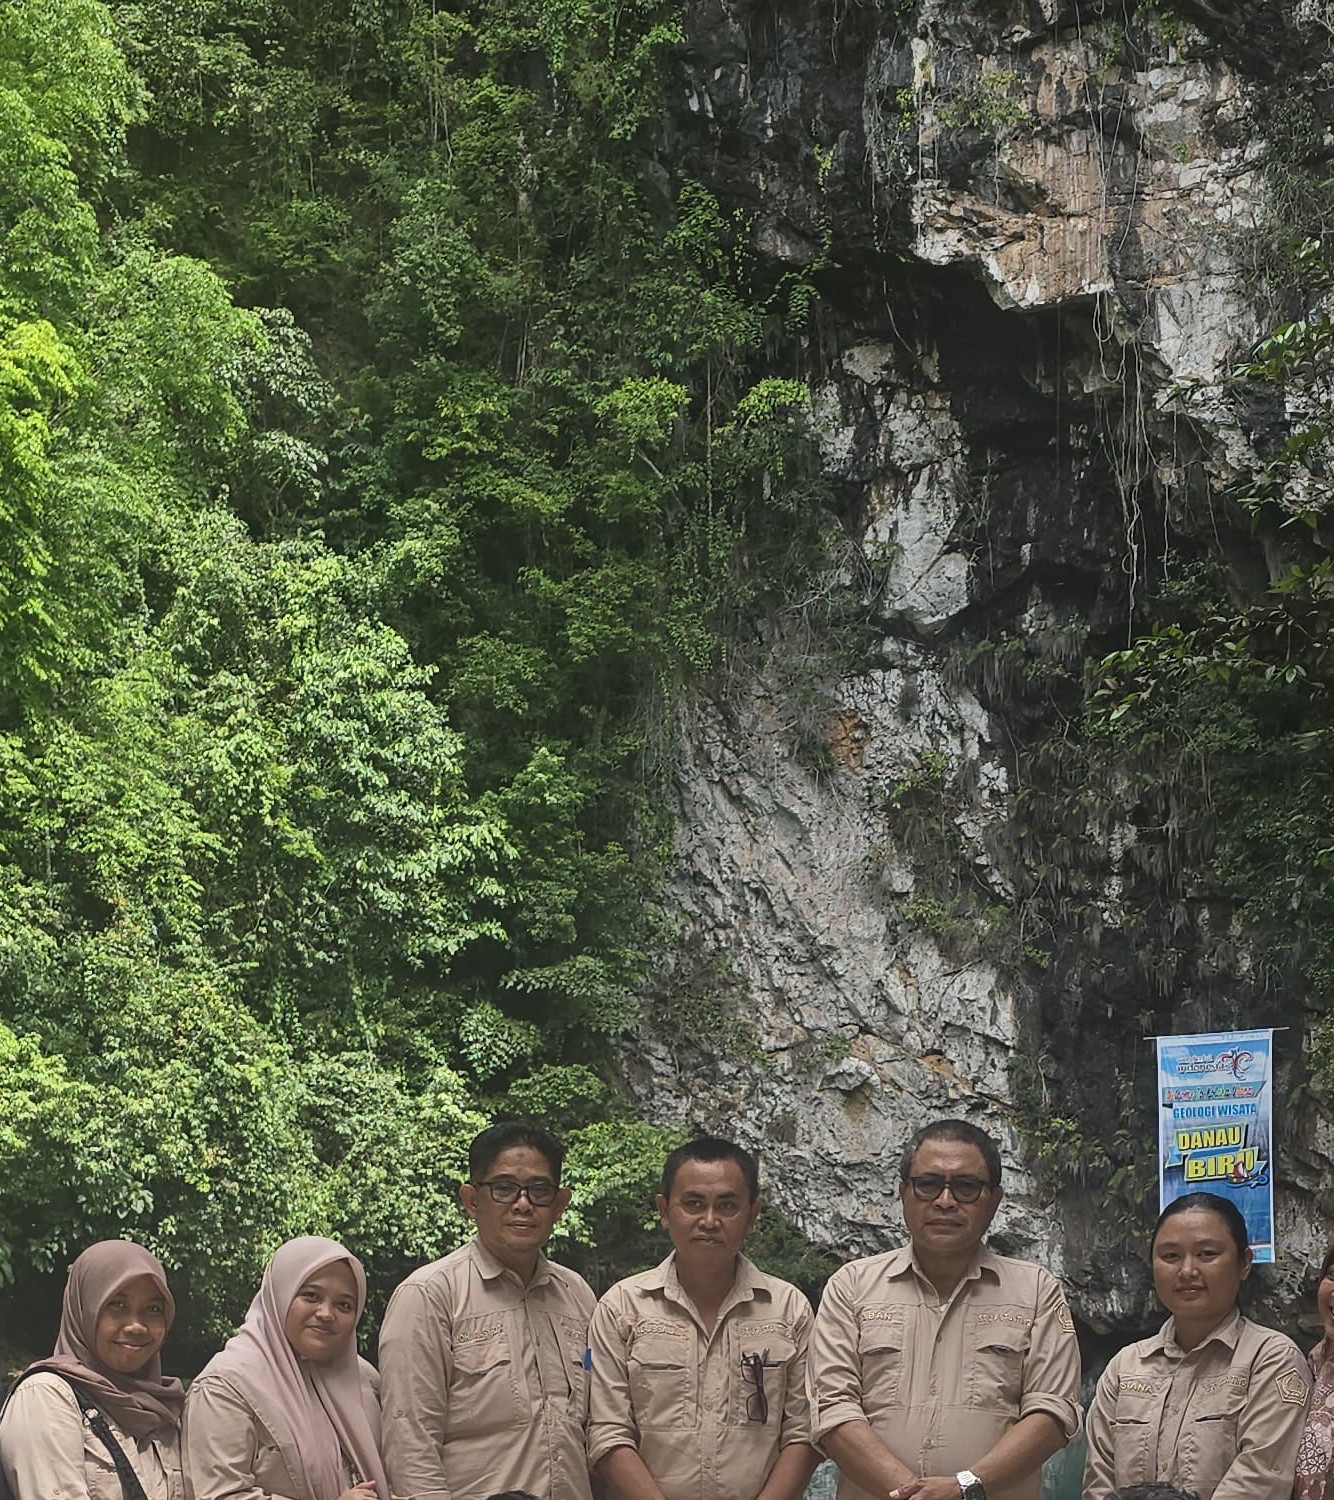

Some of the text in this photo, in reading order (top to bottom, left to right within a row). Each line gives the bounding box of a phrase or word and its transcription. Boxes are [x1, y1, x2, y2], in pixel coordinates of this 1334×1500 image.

[1173, 1103, 1257, 1120] GEOLOGI WISATA
[1178, 1126, 1242, 1151] DANAU
[1187, 1150, 1255, 1179] BIRU
